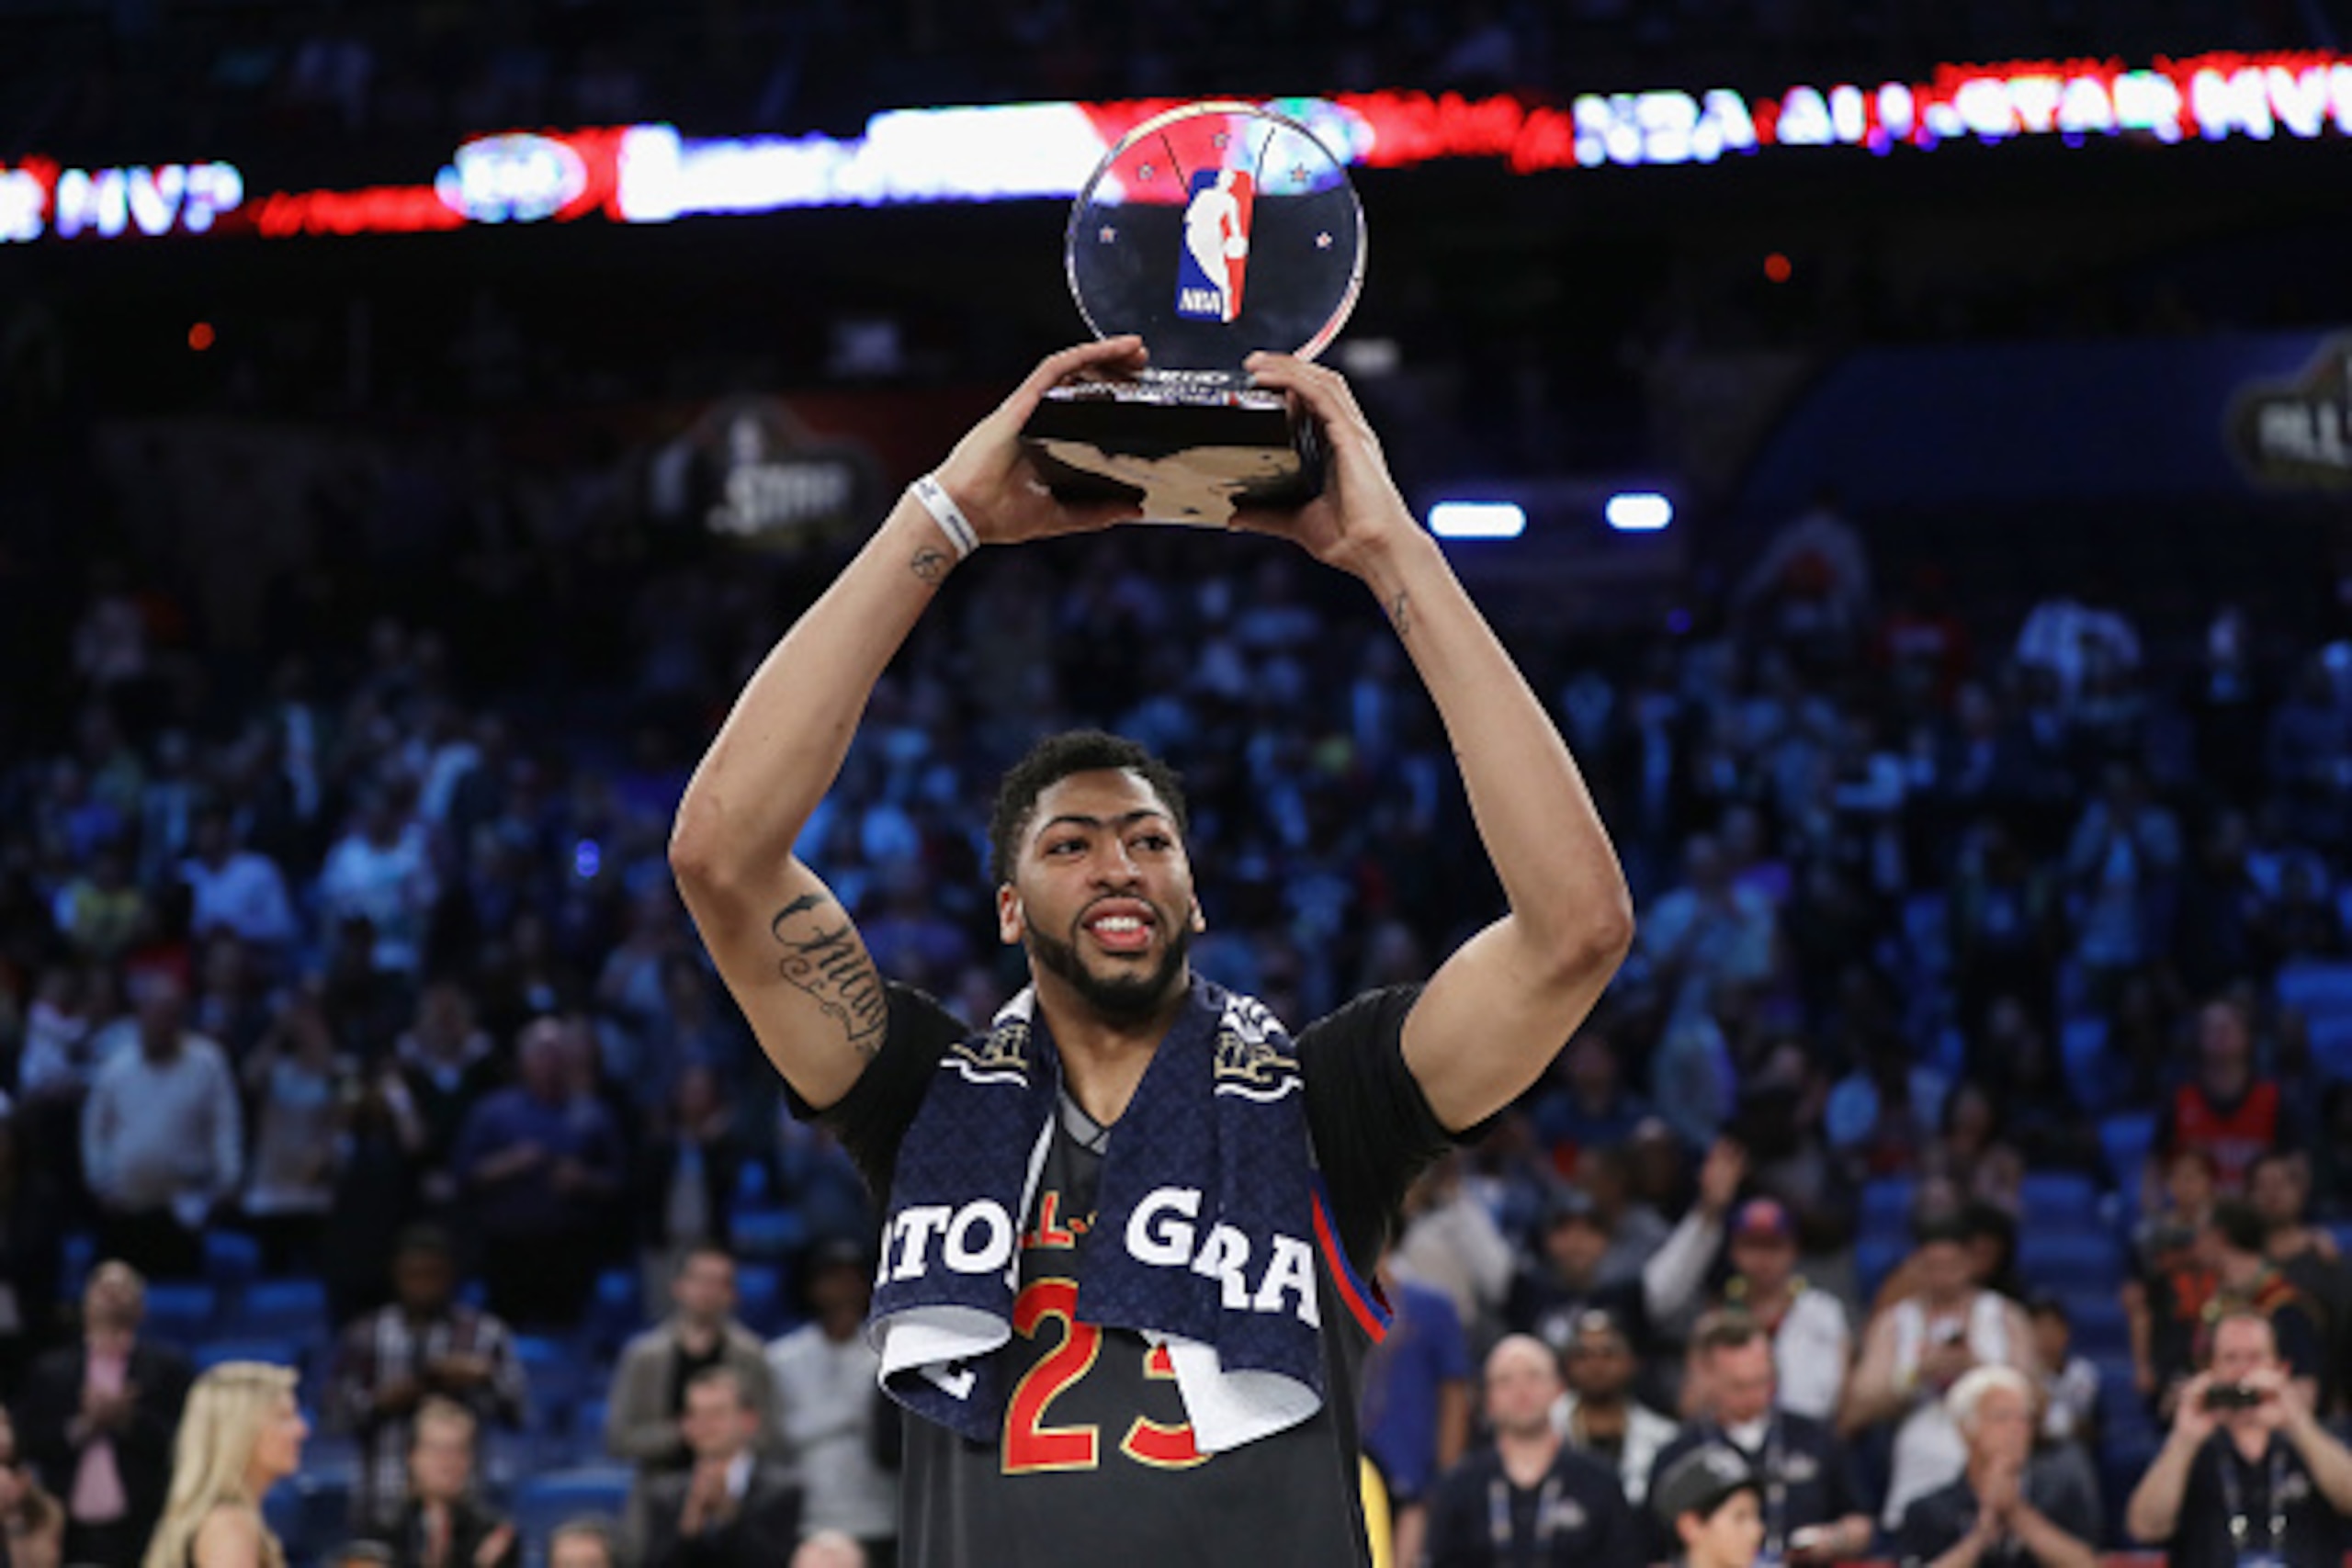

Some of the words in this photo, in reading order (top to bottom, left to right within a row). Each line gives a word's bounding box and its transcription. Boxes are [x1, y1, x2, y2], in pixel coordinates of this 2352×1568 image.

[1573, 89, 1757, 168] NBA
[56, 162, 243, 239] MVP
[1178, 287, 1222, 314] NBA
[875, 1199, 1019, 1293] TO
